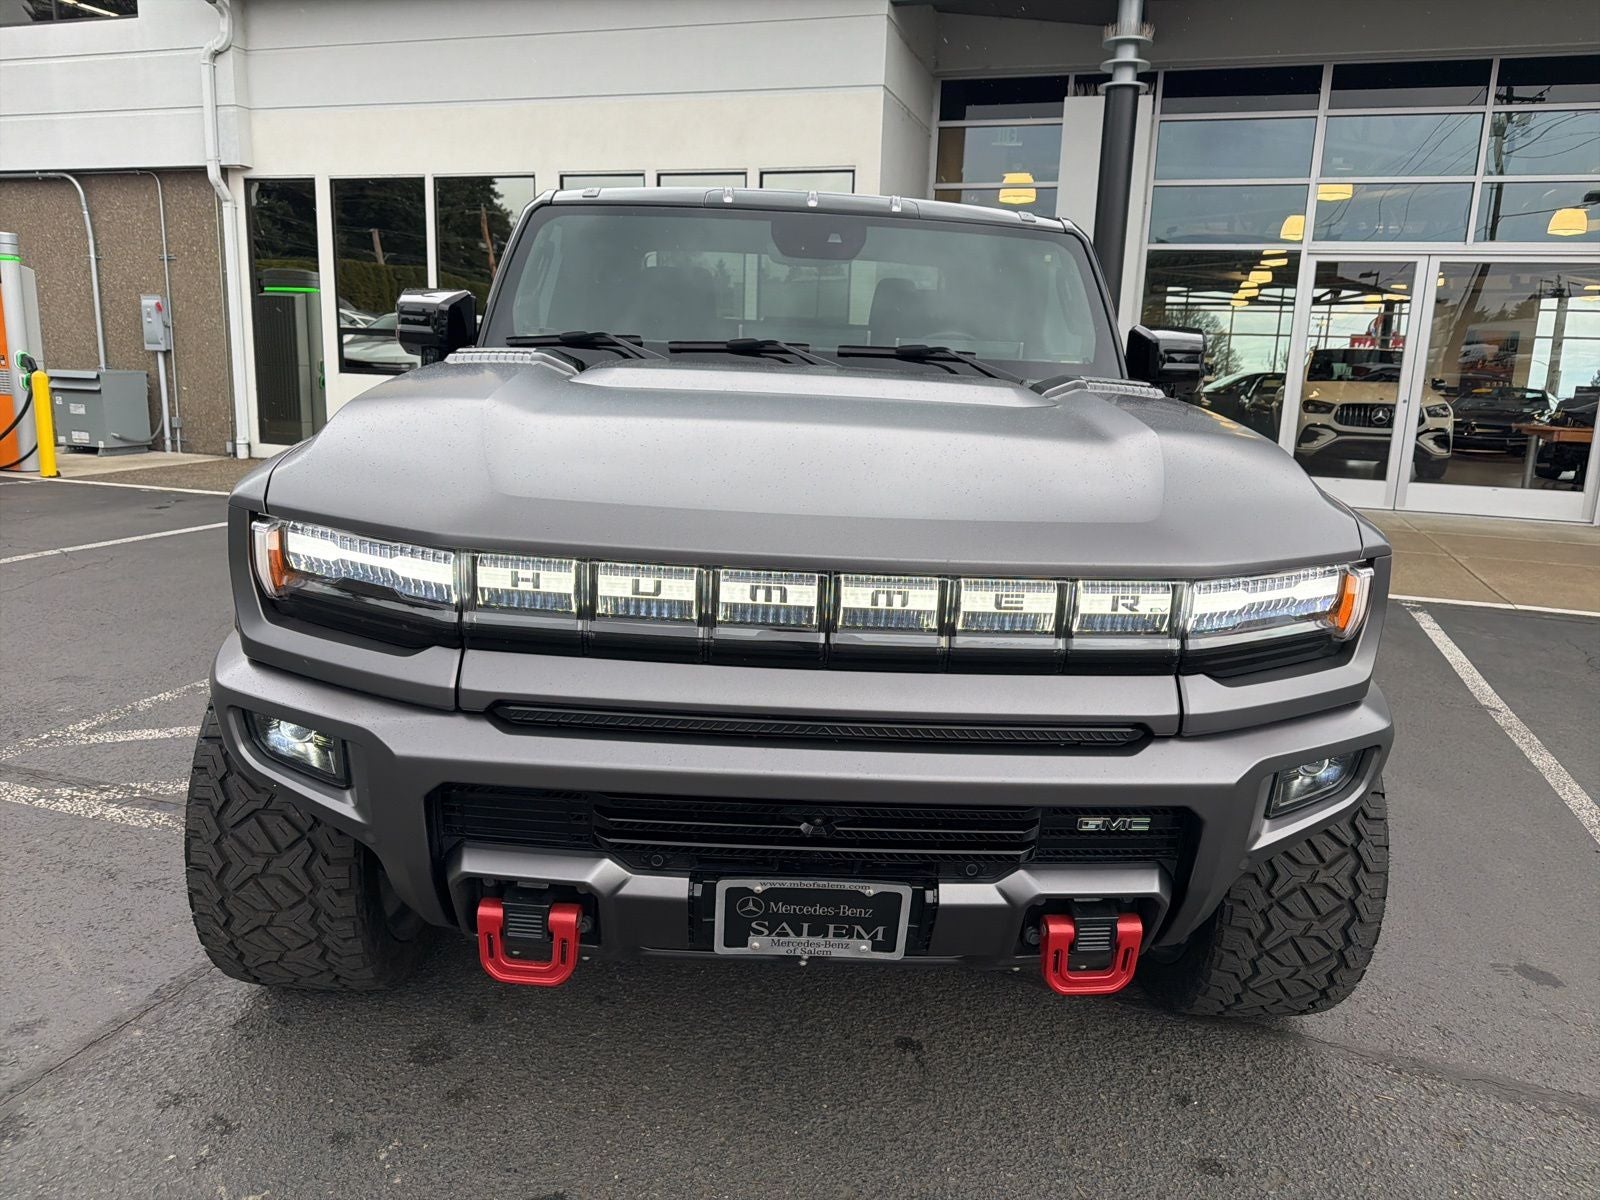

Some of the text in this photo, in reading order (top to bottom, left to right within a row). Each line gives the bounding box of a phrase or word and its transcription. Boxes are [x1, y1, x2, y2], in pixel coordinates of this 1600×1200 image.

[1077, 817, 1151, 831] GMC
[759, 880, 871, 891] www.mbofsalem.com
[769, 901, 873, 918] Mercedes-Benz
[750, 921, 888, 941] SALEM
[770, 938, 850, 950] Mercedes-Benz
[800, 947, 832, 956] Salem
